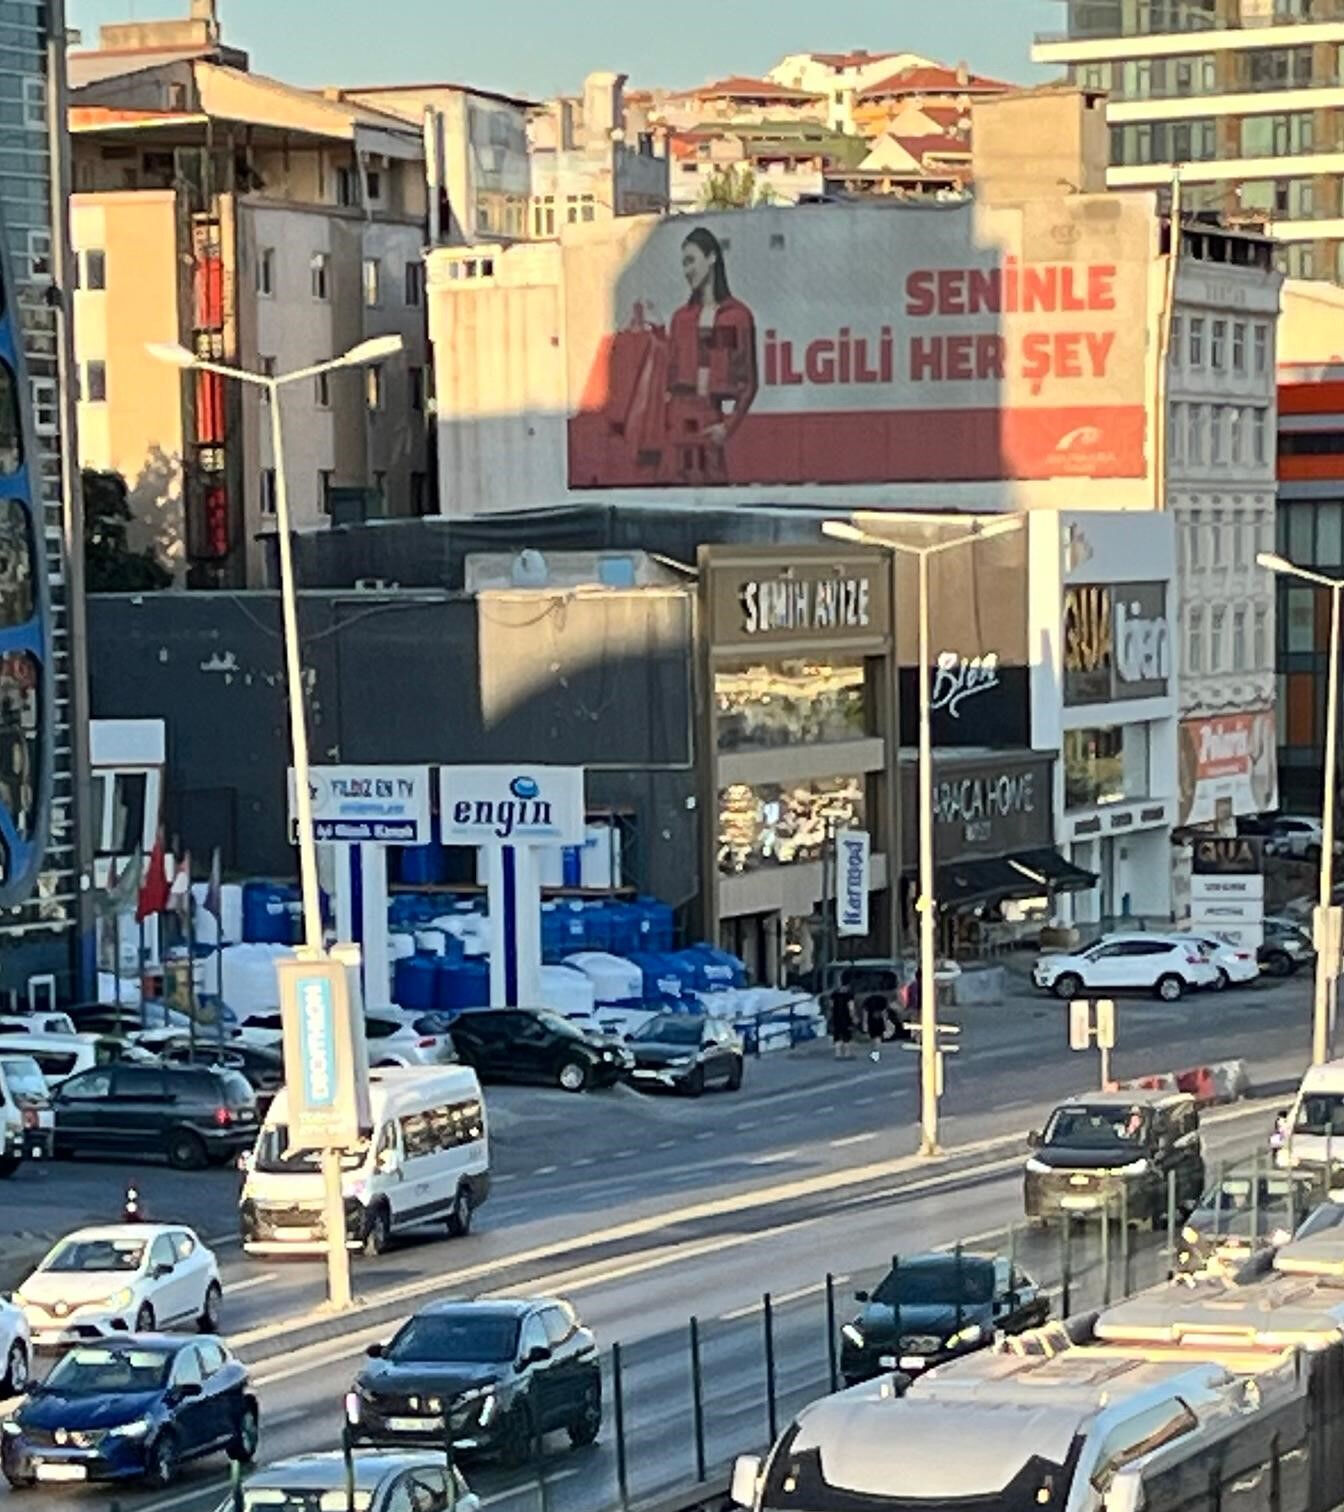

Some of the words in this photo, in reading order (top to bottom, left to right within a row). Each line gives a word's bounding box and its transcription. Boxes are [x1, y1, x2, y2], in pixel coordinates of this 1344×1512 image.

[904, 255, 1117, 317] SENİNLE
[765, 326, 894, 387] İLGİLİ
[910, 336, 1006, 381] HER
[1021, 331, 1116, 396] ŞEY
[453, 780, 552, 838] engin
